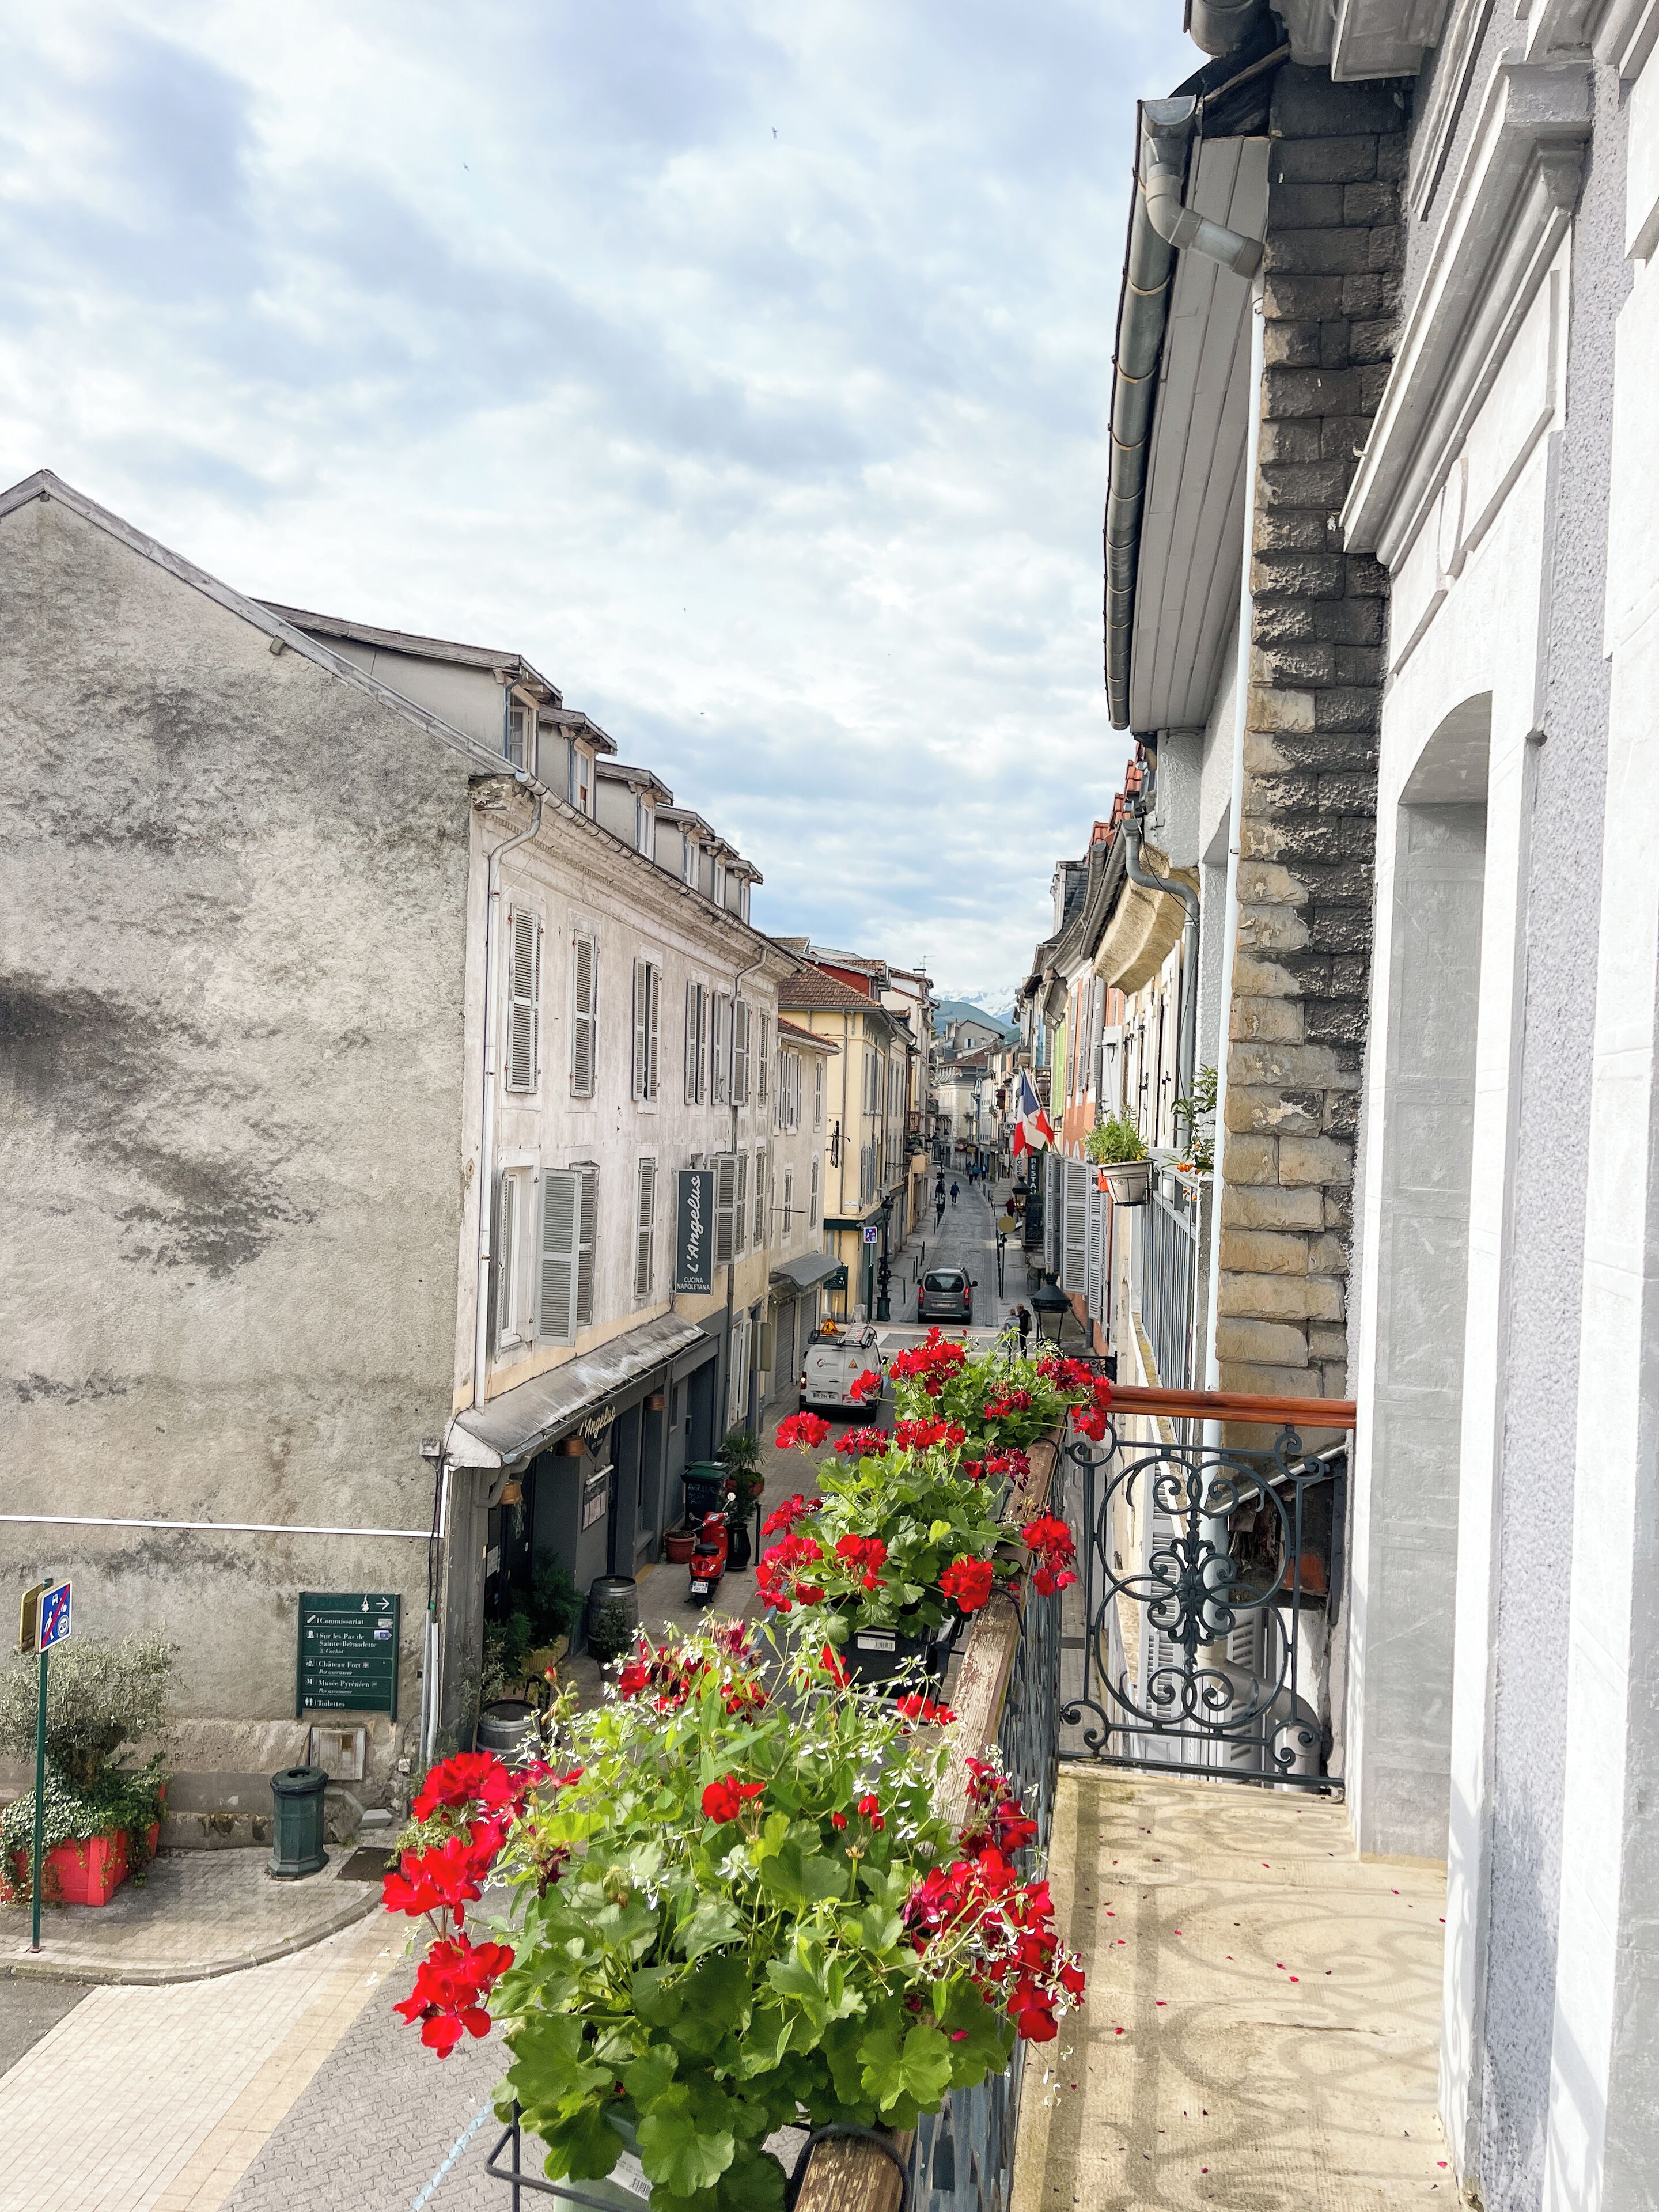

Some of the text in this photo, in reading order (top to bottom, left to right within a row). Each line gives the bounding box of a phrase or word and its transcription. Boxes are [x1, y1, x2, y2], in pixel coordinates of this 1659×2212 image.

[686, 1175, 704, 1274] L'Angelus
[60, 1620, 67, 1631] 20
[340, 1680, 370, 1690] Pyrénéen
[318, 1699, 346, 1707] Toilettes
